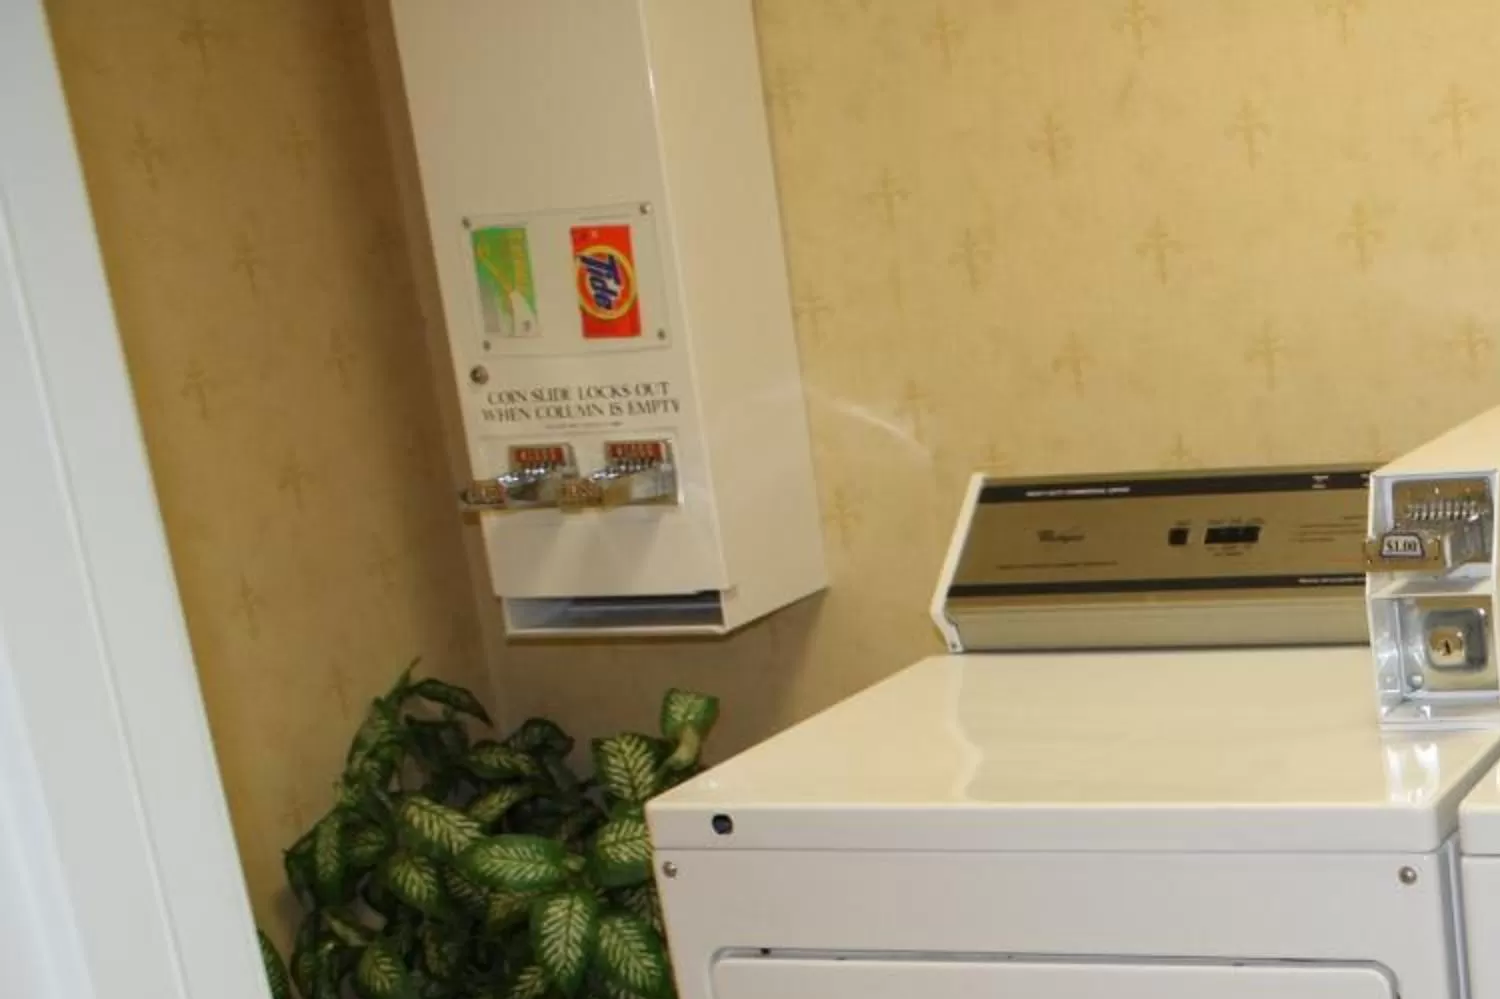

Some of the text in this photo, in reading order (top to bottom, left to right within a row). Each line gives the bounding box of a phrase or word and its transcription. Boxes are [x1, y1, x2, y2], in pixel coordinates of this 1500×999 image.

[579, 252, 621, 310] Tide
[487, 381, 670, 405] COIN SLIDE LOCKS OUT
[481, 399, 680, 423] WHEN COLUMN IS EMPTY
[1386, 539, 1418, 553] $1.00
